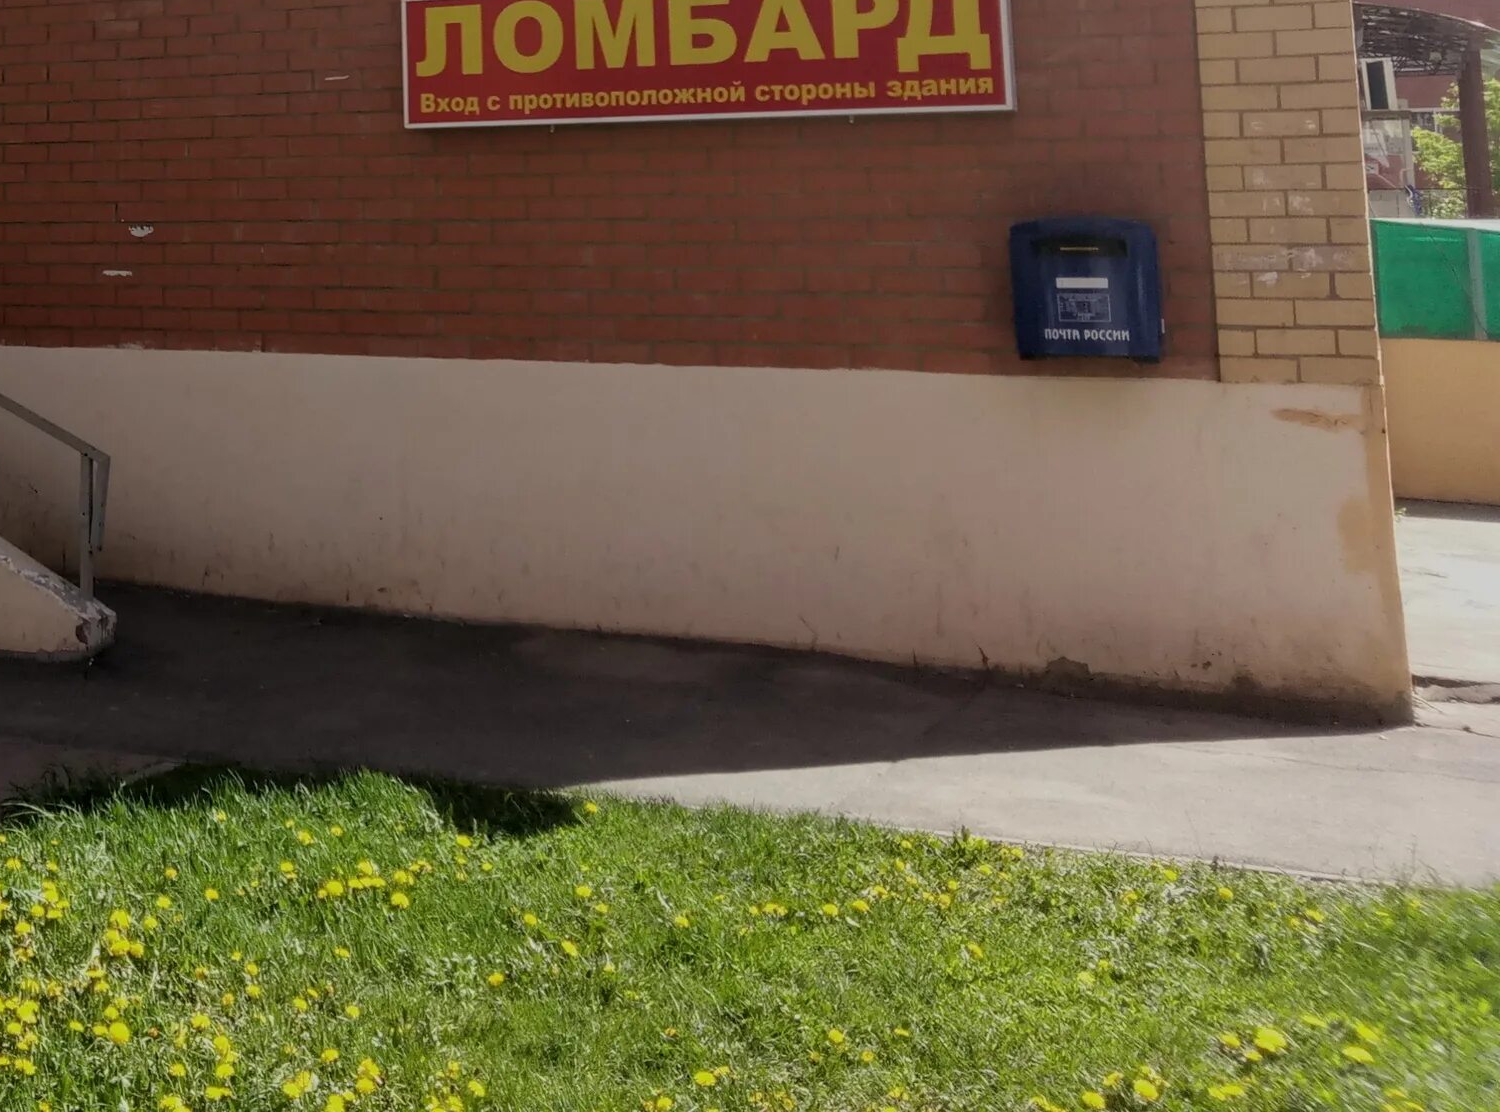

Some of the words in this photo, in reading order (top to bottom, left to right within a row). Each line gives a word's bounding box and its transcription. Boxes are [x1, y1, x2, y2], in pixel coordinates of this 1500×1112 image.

[420, 93, 480, 115] Вход
[486, 94, 501, 111] с
[509, 81, 746, 114] противоположной
[755, 81, 875, 105] стороны
[886, 77, 994, 101] здания
[1044, 328, 1081, 341] ПОЧТА
[1084, 328, 1130, 341] РОССИИ
